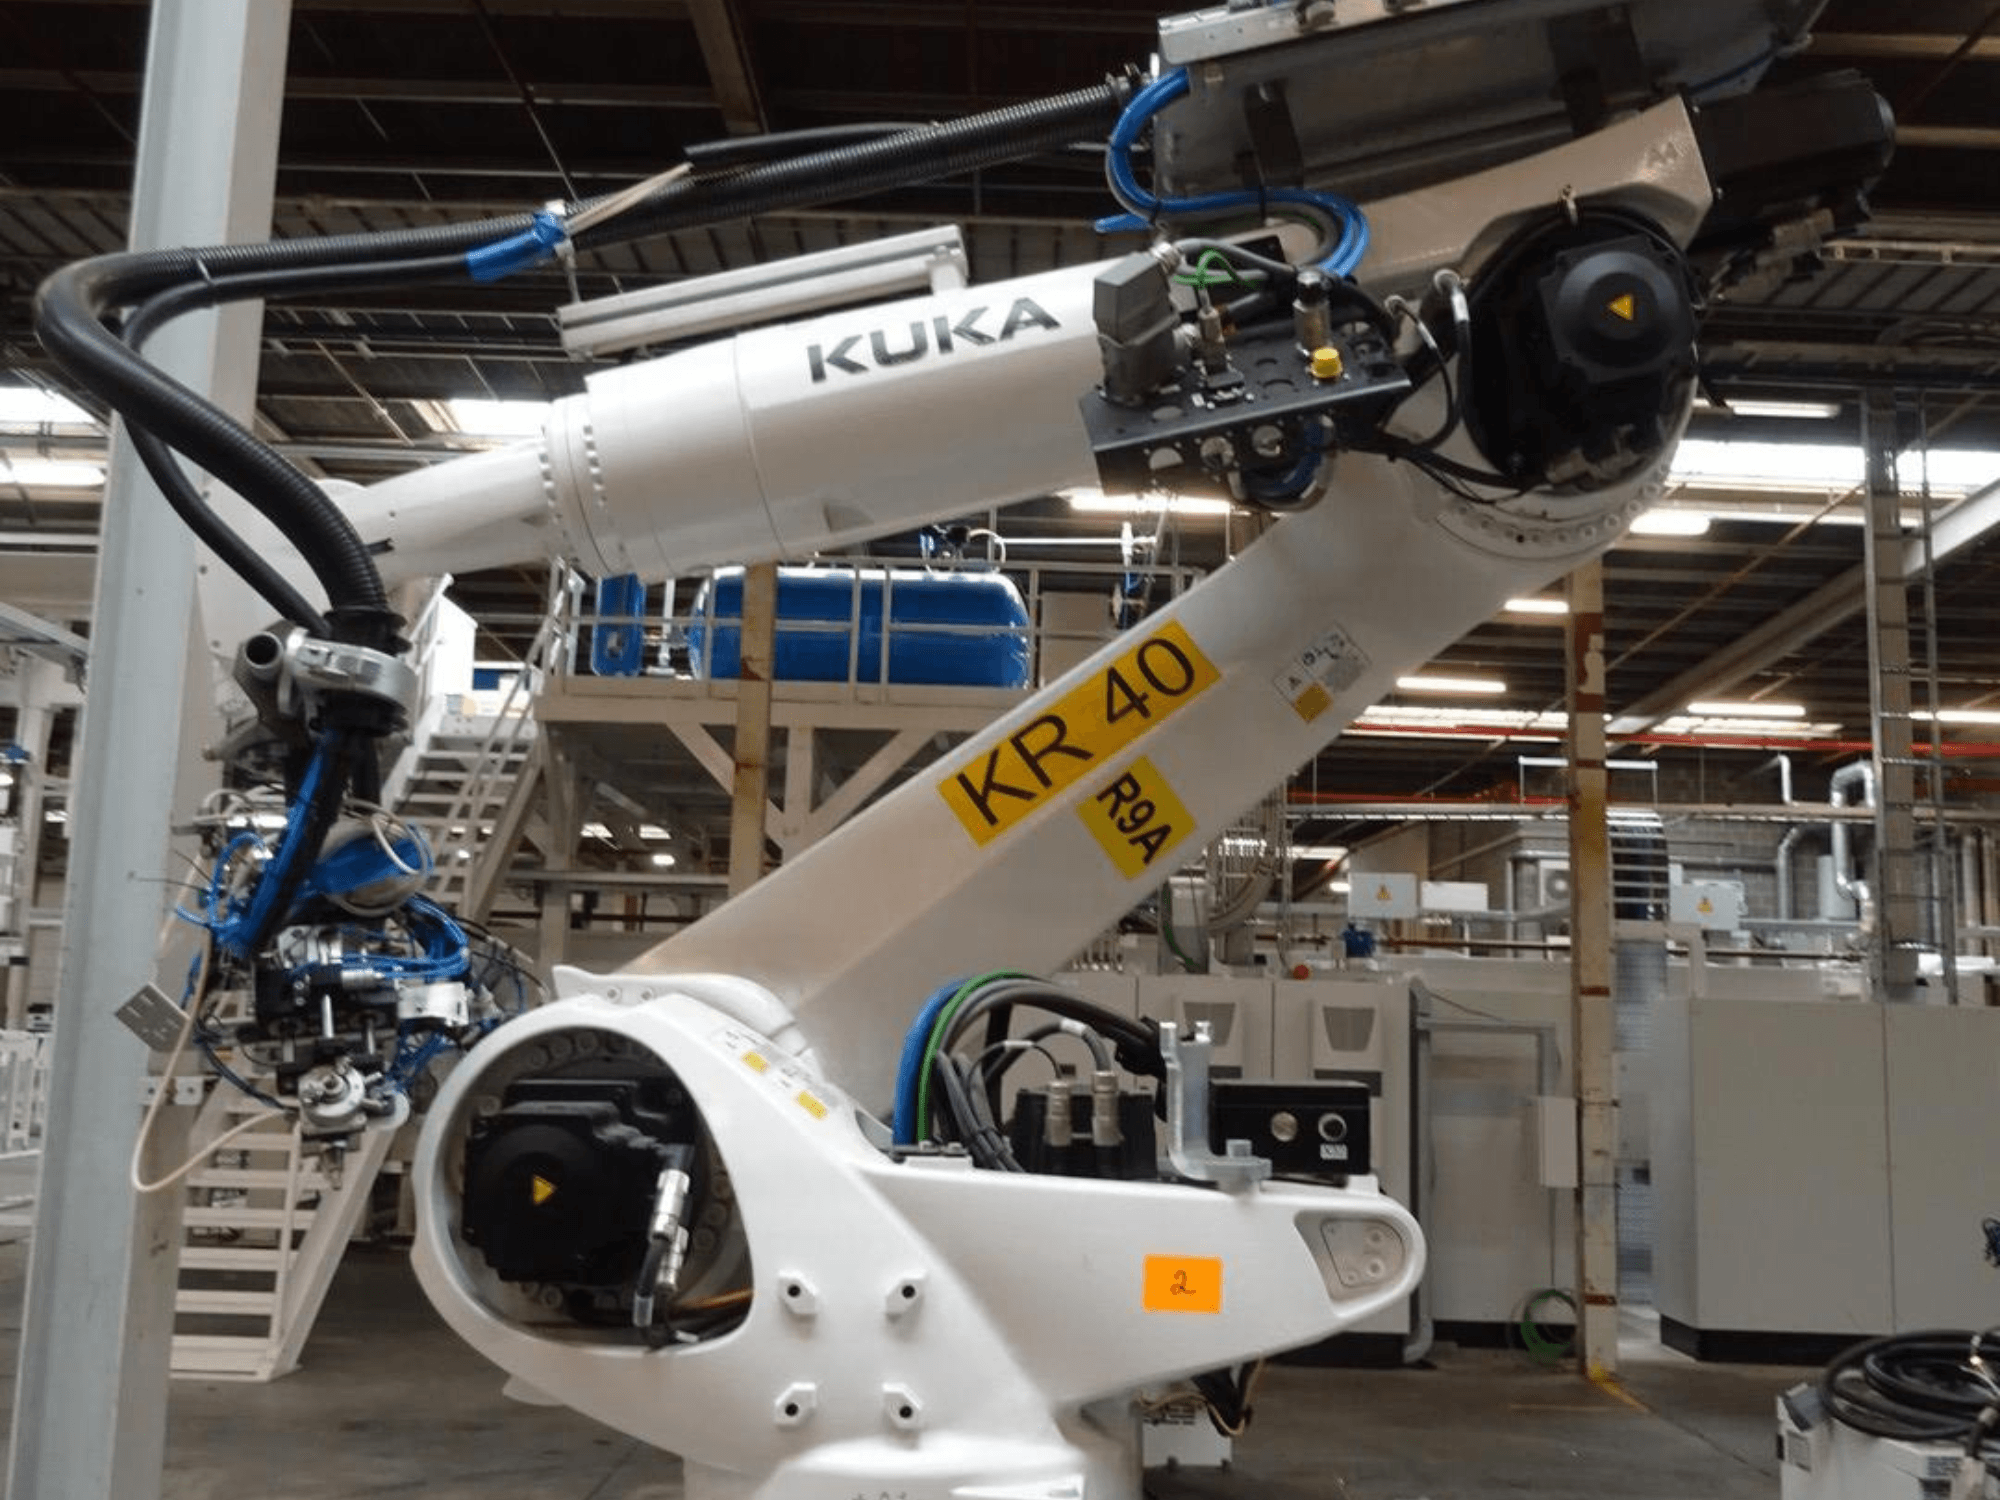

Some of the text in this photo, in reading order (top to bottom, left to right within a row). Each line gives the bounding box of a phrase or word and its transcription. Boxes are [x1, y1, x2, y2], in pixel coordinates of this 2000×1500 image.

[807, 297, 1061, 383] KUKA
[957, 638, 1196, 826] KR 40
[1096, 772, 1172, 864] R9A
[1169, 1269, 1197, 1296] 2
